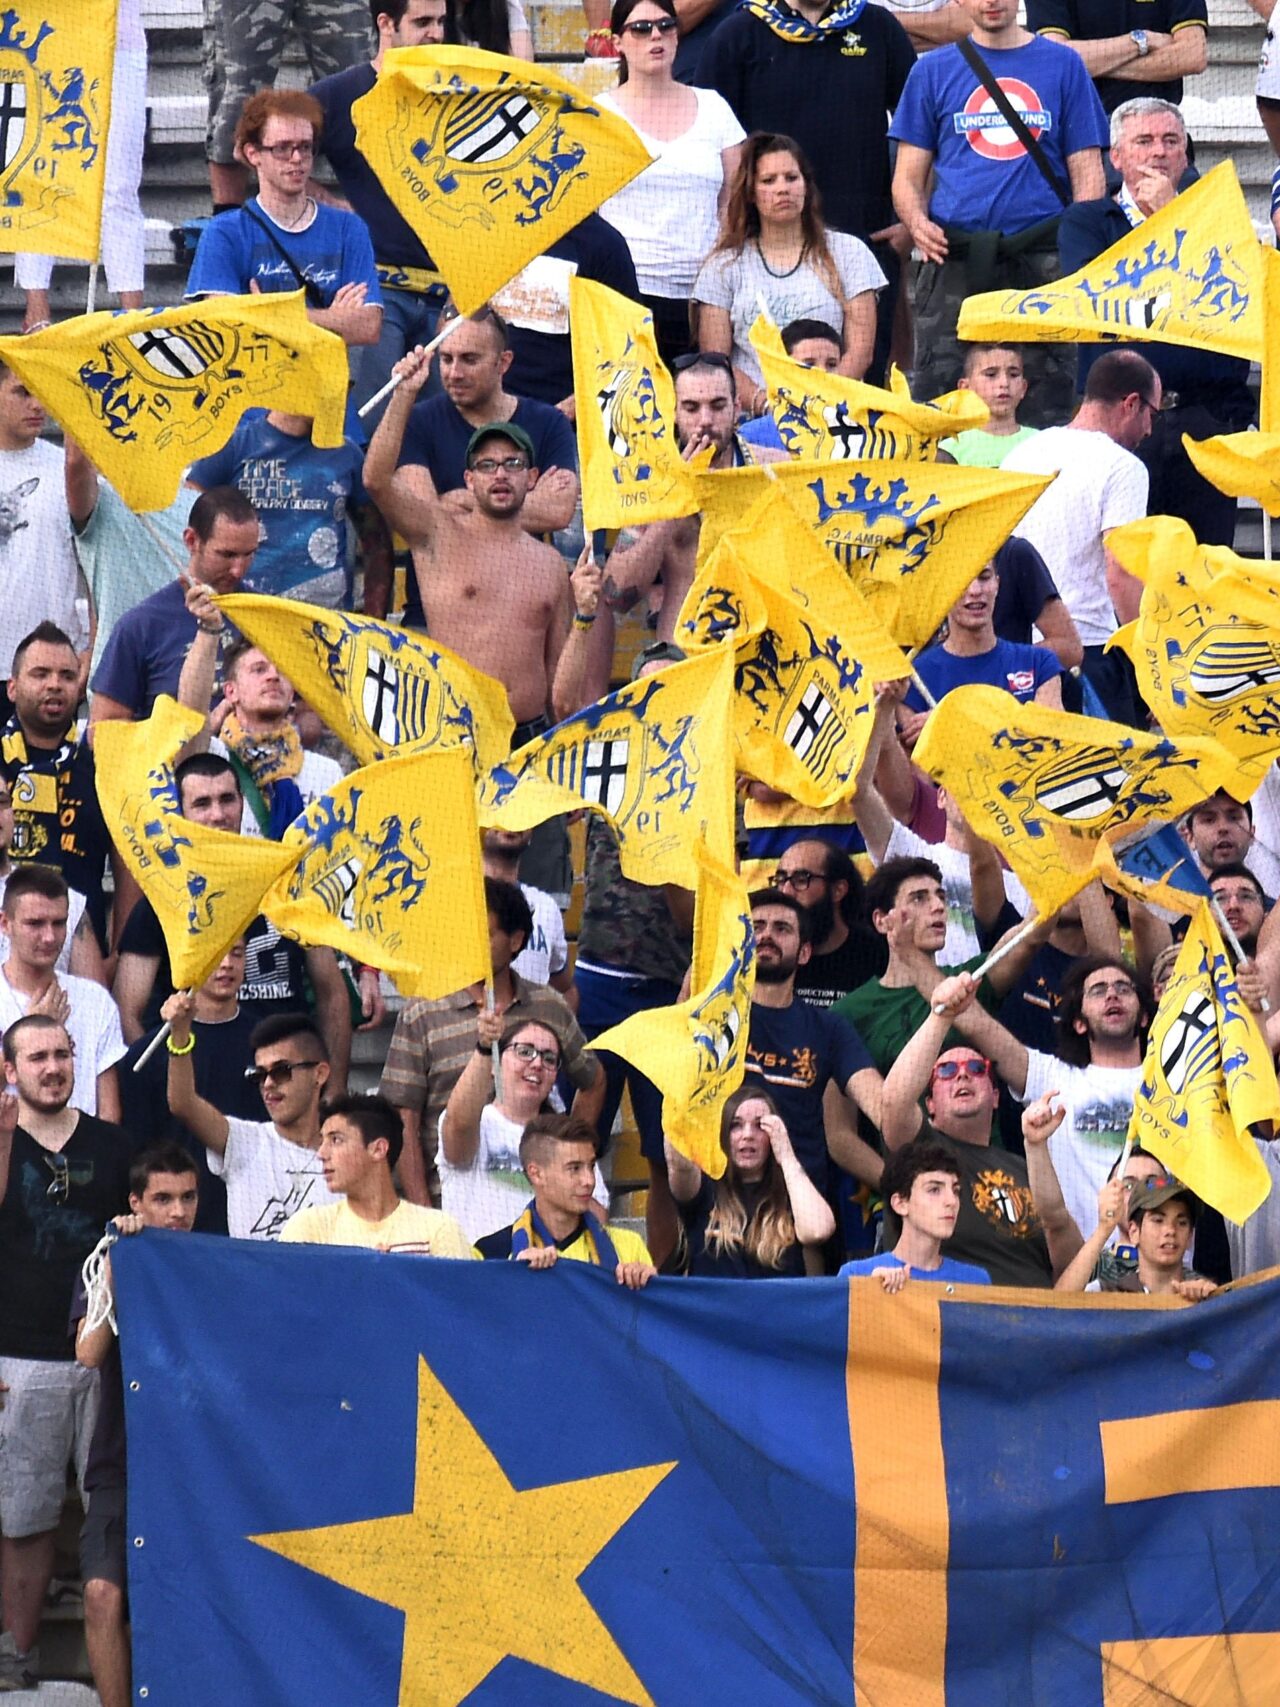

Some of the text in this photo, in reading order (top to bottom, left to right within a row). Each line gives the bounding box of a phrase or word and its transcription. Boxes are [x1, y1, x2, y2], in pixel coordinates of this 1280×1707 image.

[960, 113, 1046, 129] UNDERGUND
[243, 345, 268, 363] 77
[147, 393, 172, 423] 19
[210, 384, 243, 418] BOYS
[243, 459, 286, 482] TIME
[813, 669, 841, 713] PARMA
[1139, 1108, 1171, 1139] OYS
